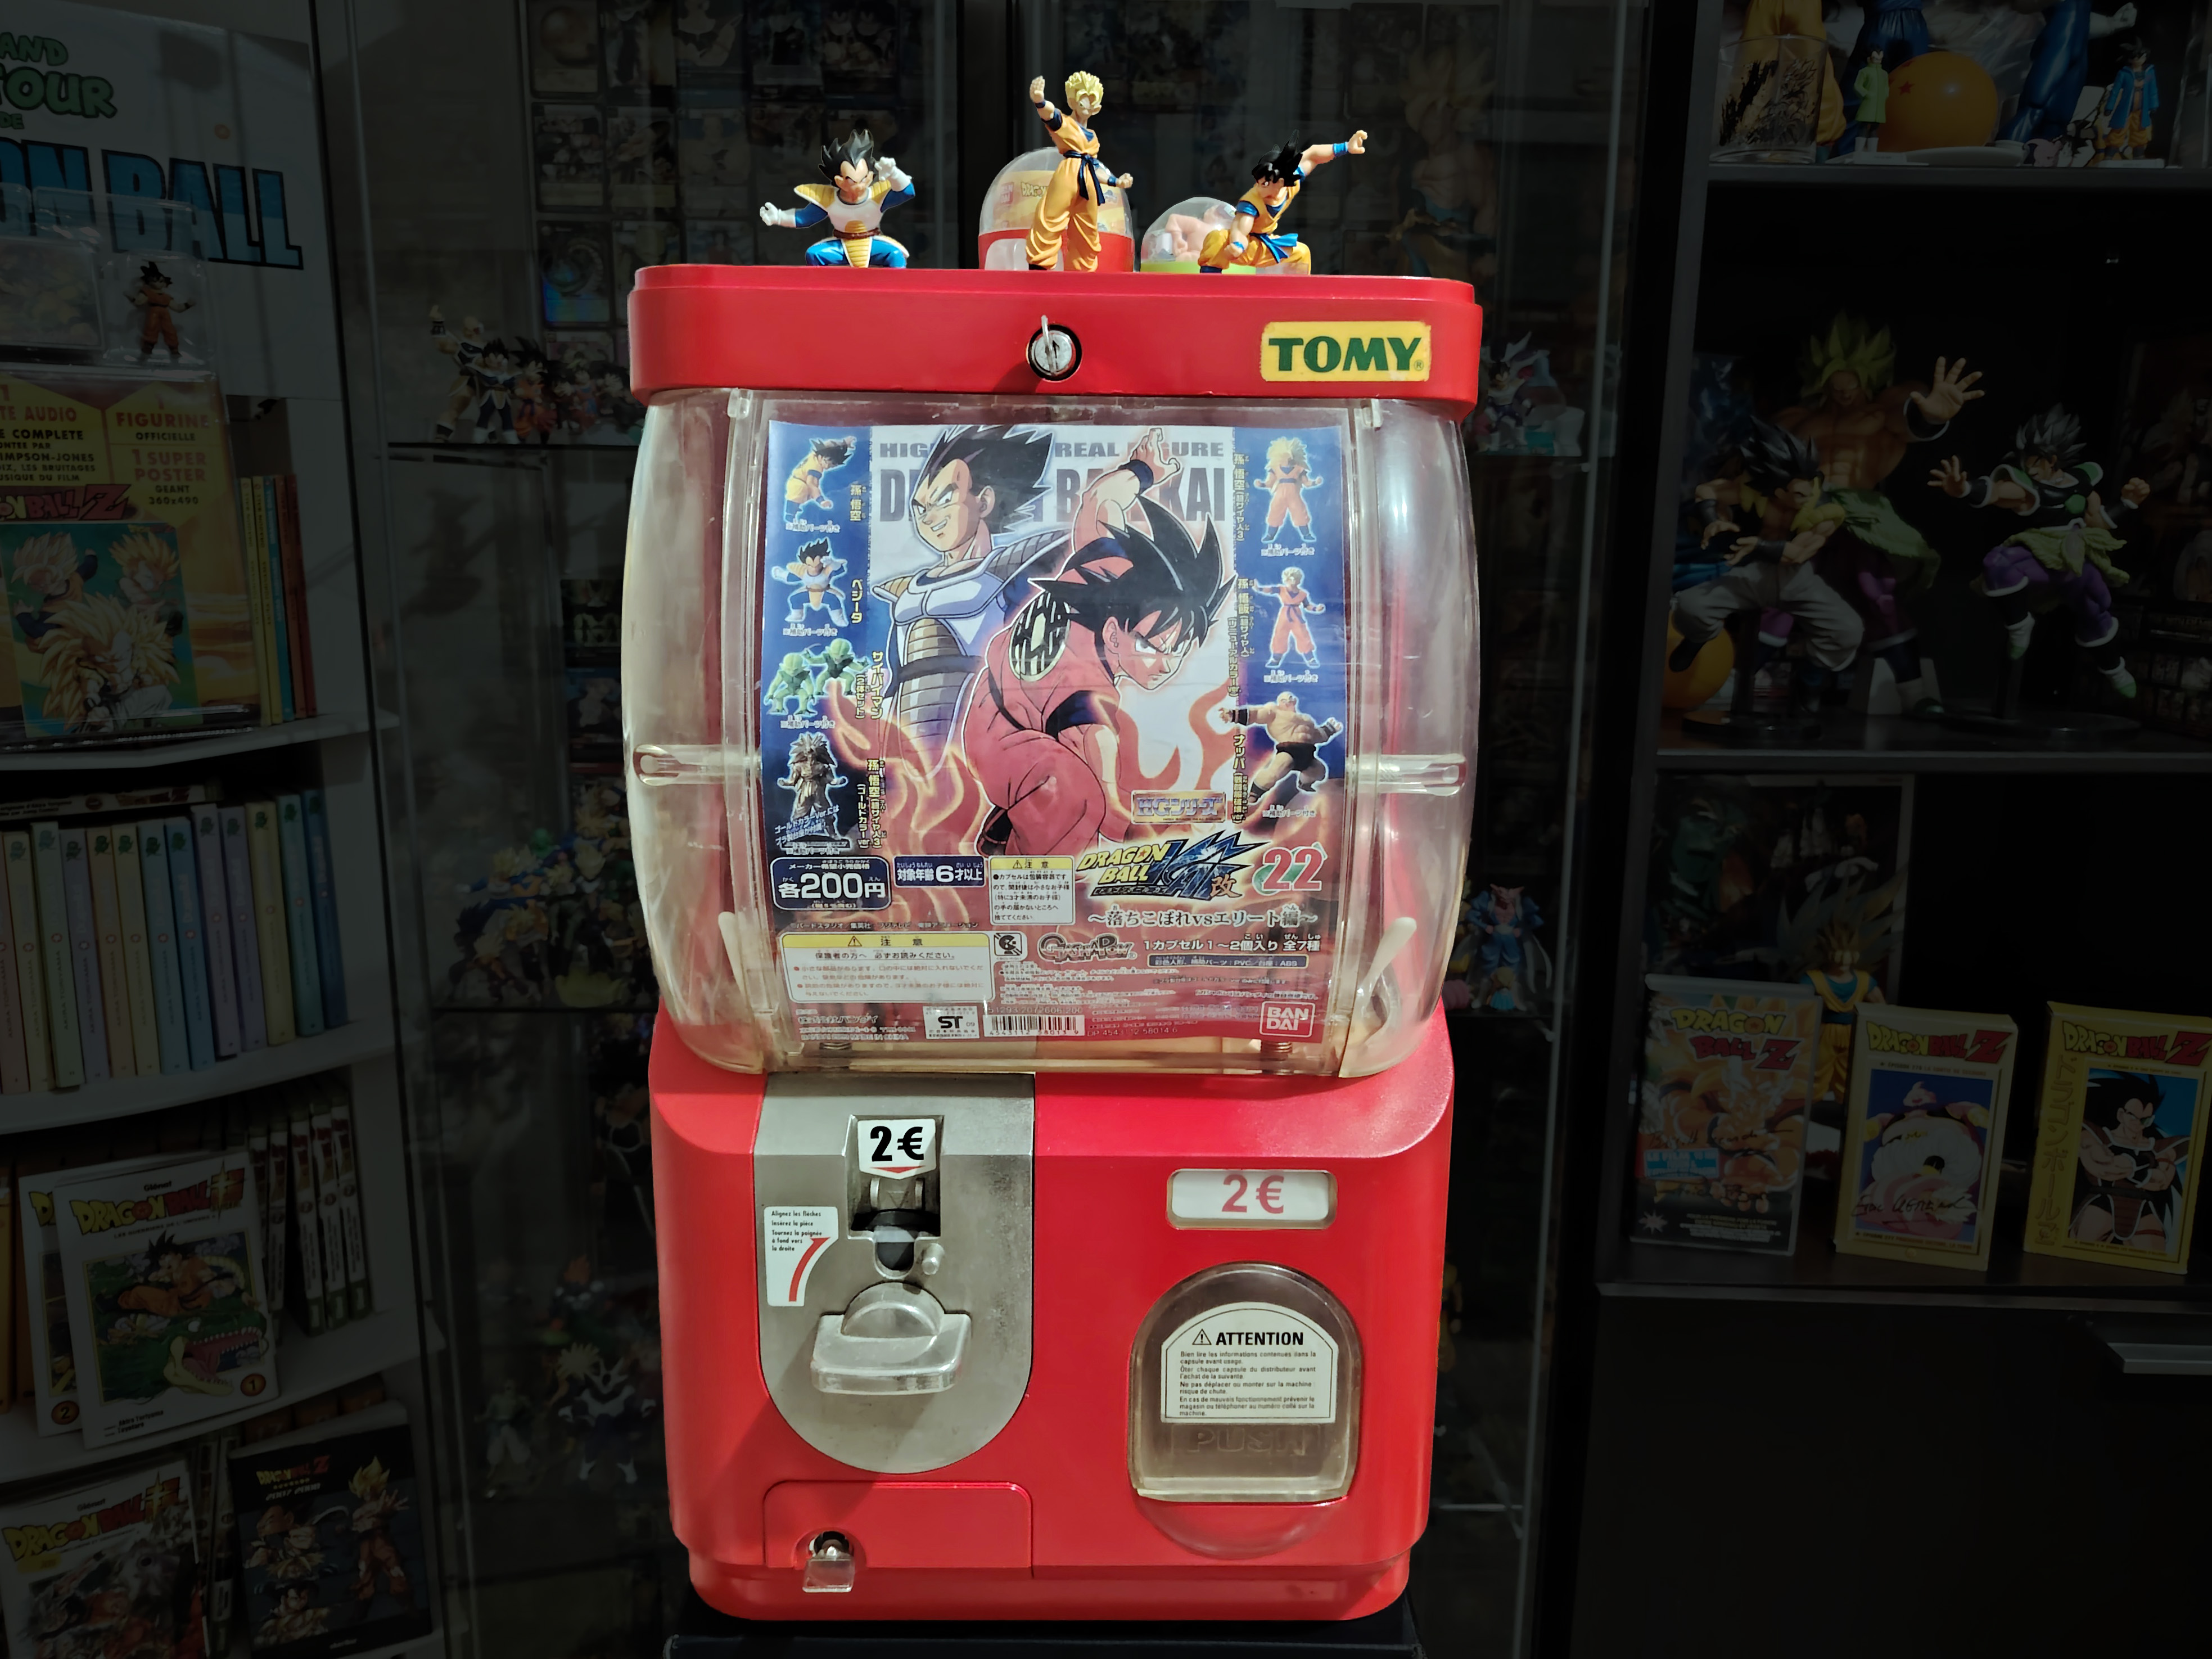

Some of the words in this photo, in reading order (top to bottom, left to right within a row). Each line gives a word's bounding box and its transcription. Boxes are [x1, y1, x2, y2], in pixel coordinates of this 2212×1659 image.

[101, 149, 304, 270] BALL
[1268, 336, 1422, 372] TOMY
[25, 406, 76, 422] AUDIO
[116, 412, 209, 428] FIGURINE
[13, 429, 83, 440] COMPLETE
[136, 432, 196, 441] OFFICIELLE
[148, 452, 206, 466] SUPER
[1055, 441, 1119, 457] REAL
[135, 468, 206, 482] POSTER
[25, 489, 81, 521] BALL
[79, 484, 132, 521] Z
[851, 578, 863, 624] ベジータ
[872, 651, 883, 719] サイバイマン
[1076, 844, 1171, 872] DRAGON
[1262, 847, 1322, 891] 22
[778, 872, 886, 899] 各200円
[896, 865, 983, 882] 対象年齢6才以上
[1098, 863, 1151, 885] BALL
[1211, 874, 1243, 899] 改
[937, 1016, 964, 1029] ST
[1266, 1018, 1298, 1030] DAI
[1267, 1007, 1309, 1018] BAN
[1669, 1008, 1786, 1034] DRAGON
[1689, 1035, 1757, 1061] BALL
[1755, 1039, 1802, 1070] Z
[1866, 1021, 1929, 1056] DRAGON
[1929, 1033, 1968, 1058] BALL
[1965, 1029, 2012, 1064] Z
[2062, 1020, 2128, 1057] DRAGON
[2127, 1035, 2168, 1060] BALL
[2164, 1031, 2212, 1066] Z
[870, 1126, 924, 1162] 2€
[69, 1196, 167, 1235] DRAGON
[164, 1179, 212, 1217] BALL
[1216, 1332, 1303, 1345] ATTENTION
[61, 1407, 70, 1419] 2
[313, 1454, 331, 1474] Z
[2, 1513, 99, 1561] DRAGON
[97, 1493, 145, 1532] BALL
